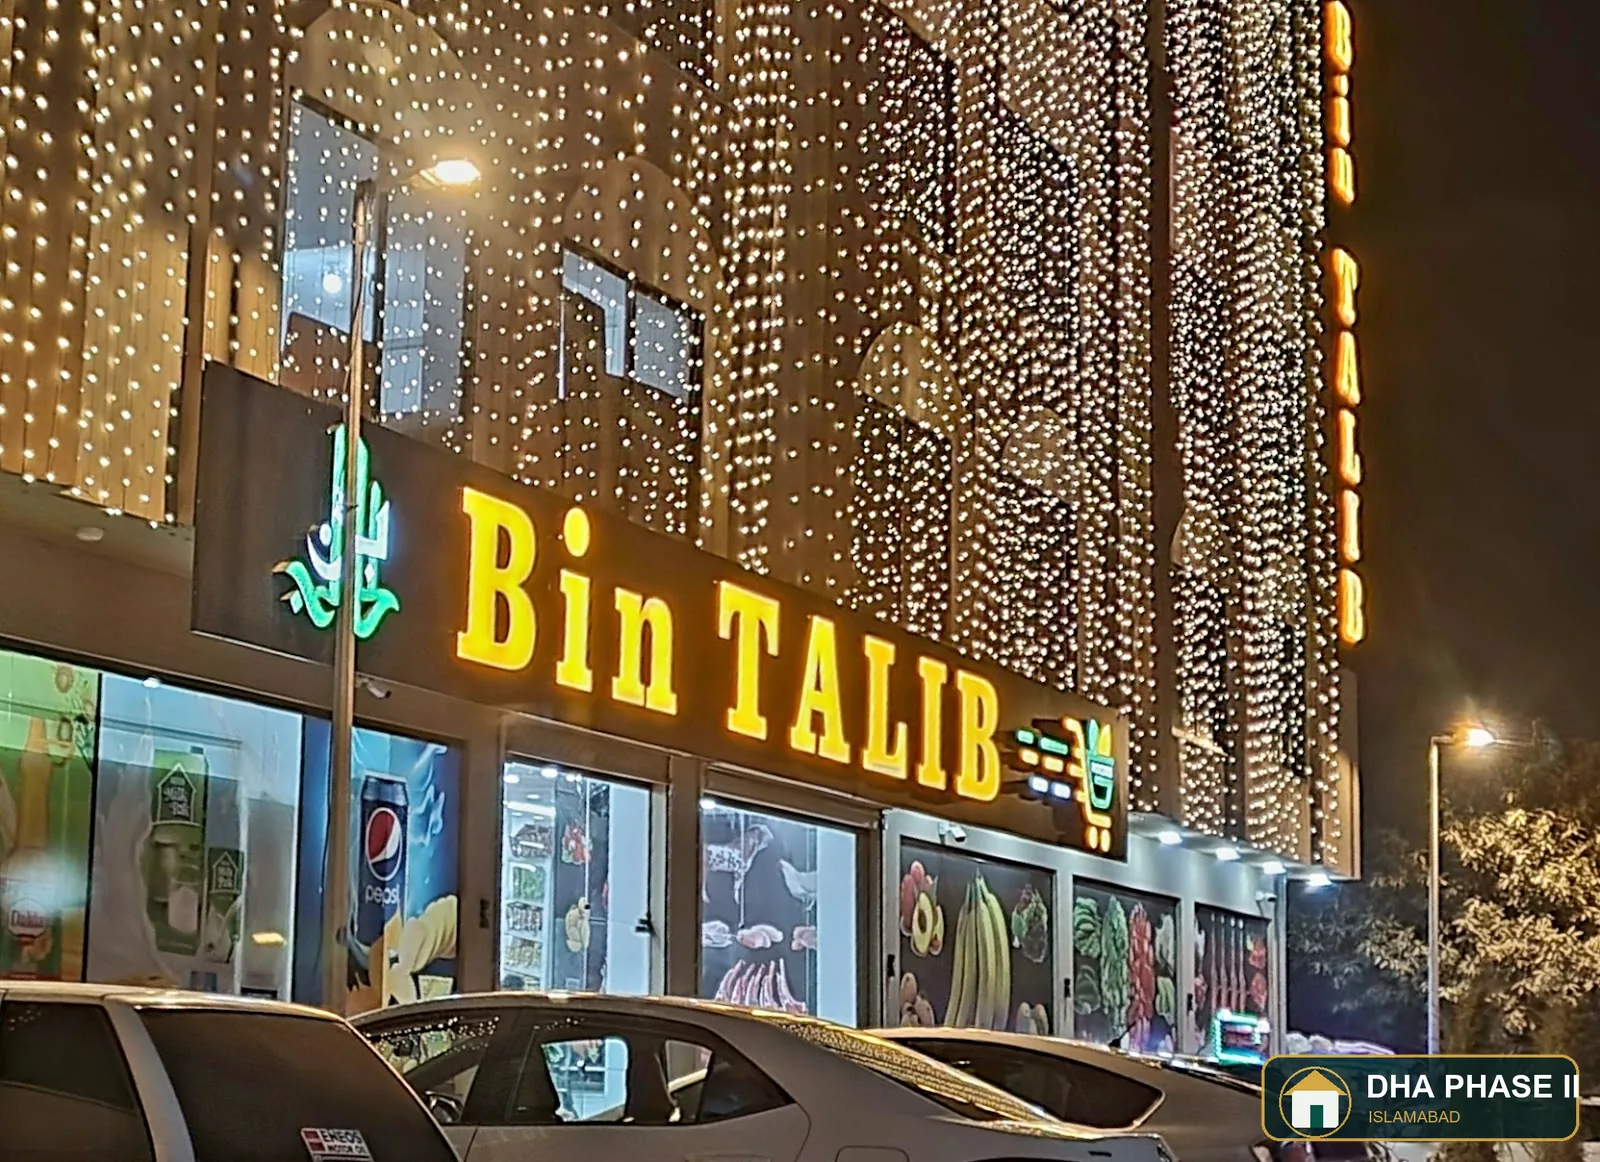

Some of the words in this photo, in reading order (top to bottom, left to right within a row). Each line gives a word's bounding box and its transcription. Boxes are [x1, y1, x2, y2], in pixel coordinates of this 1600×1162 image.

[1323, 0, 1355, 205] Bin
[1332, 247, 1364, 646] TALIB
[457, 486, 678, 716] Bin
[717, 580, 1001, 802] TALIB
[364, 882, 401, 908] pepsi
[320, 1129, 362, 1144] ENEOS
